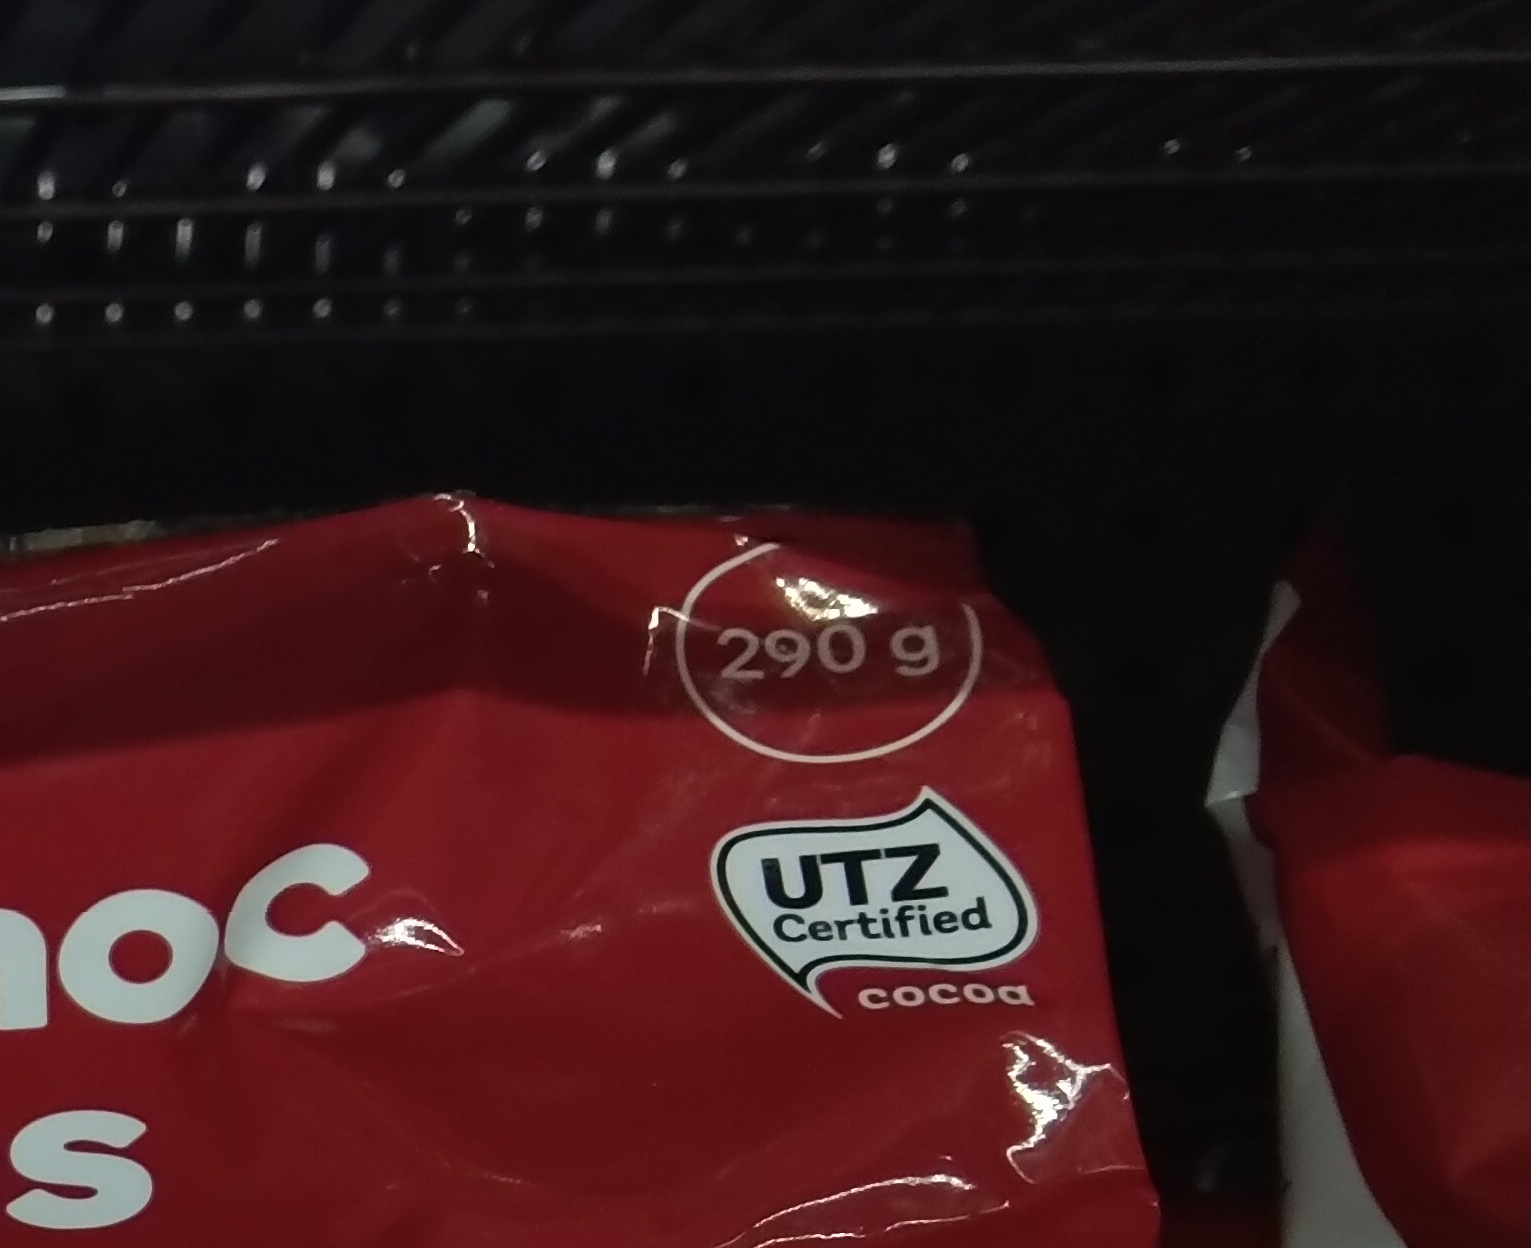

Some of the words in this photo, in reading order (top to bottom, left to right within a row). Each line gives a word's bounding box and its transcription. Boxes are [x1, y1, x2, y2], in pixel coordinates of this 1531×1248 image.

[717, 625, 866, 681] 290
[891, 622, 940, 677] g
[760, 843, 949, 910] UTZ
[772, 896, 992, 944] Certified
[857, 983, 1036, 1010] cocoa
